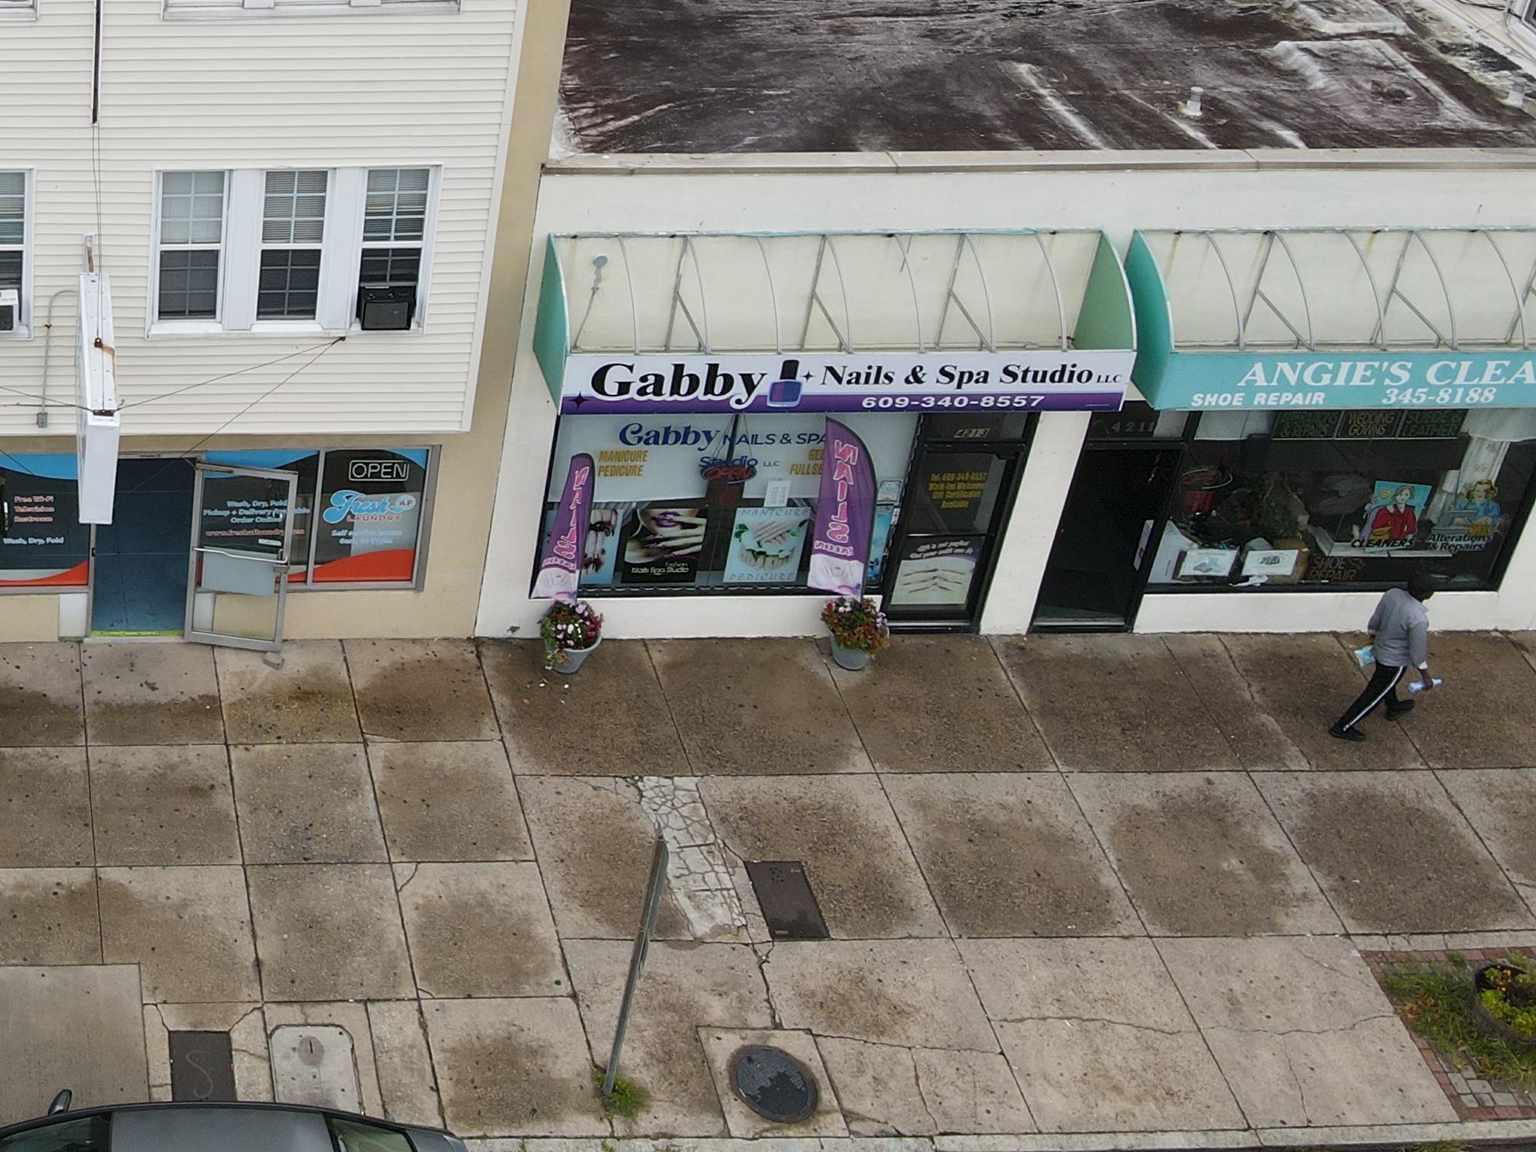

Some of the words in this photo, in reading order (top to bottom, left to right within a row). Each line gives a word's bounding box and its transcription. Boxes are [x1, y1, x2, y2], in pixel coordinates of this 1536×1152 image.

[590, 362, 767, 407] Gabby
[821, 365, 895, 386] Nails
[904, 365, 928, 385] &
[936, 364, 990, 389] Spa
[999, 363, 1093, 385] Studio
[1096, 374, 1122, 384] LLC
[1237, 360, 1413, 387] ANGIE'S
[1426, 360, 1536, 386] CLEA
[861, 395, 1046, 410] 609-340-8557
[1191, 393, 1245, 407] SHOE
[1254, 392, 1325, 406] REPAIR
[1382, 387, 1497, 405] 345-8188
[619, 423, 720, 451] Gabby
[780, 433, 792, 445] &
[352, 463, 408, 479] OPEN
[323, 489, 391, 524] Fresh
